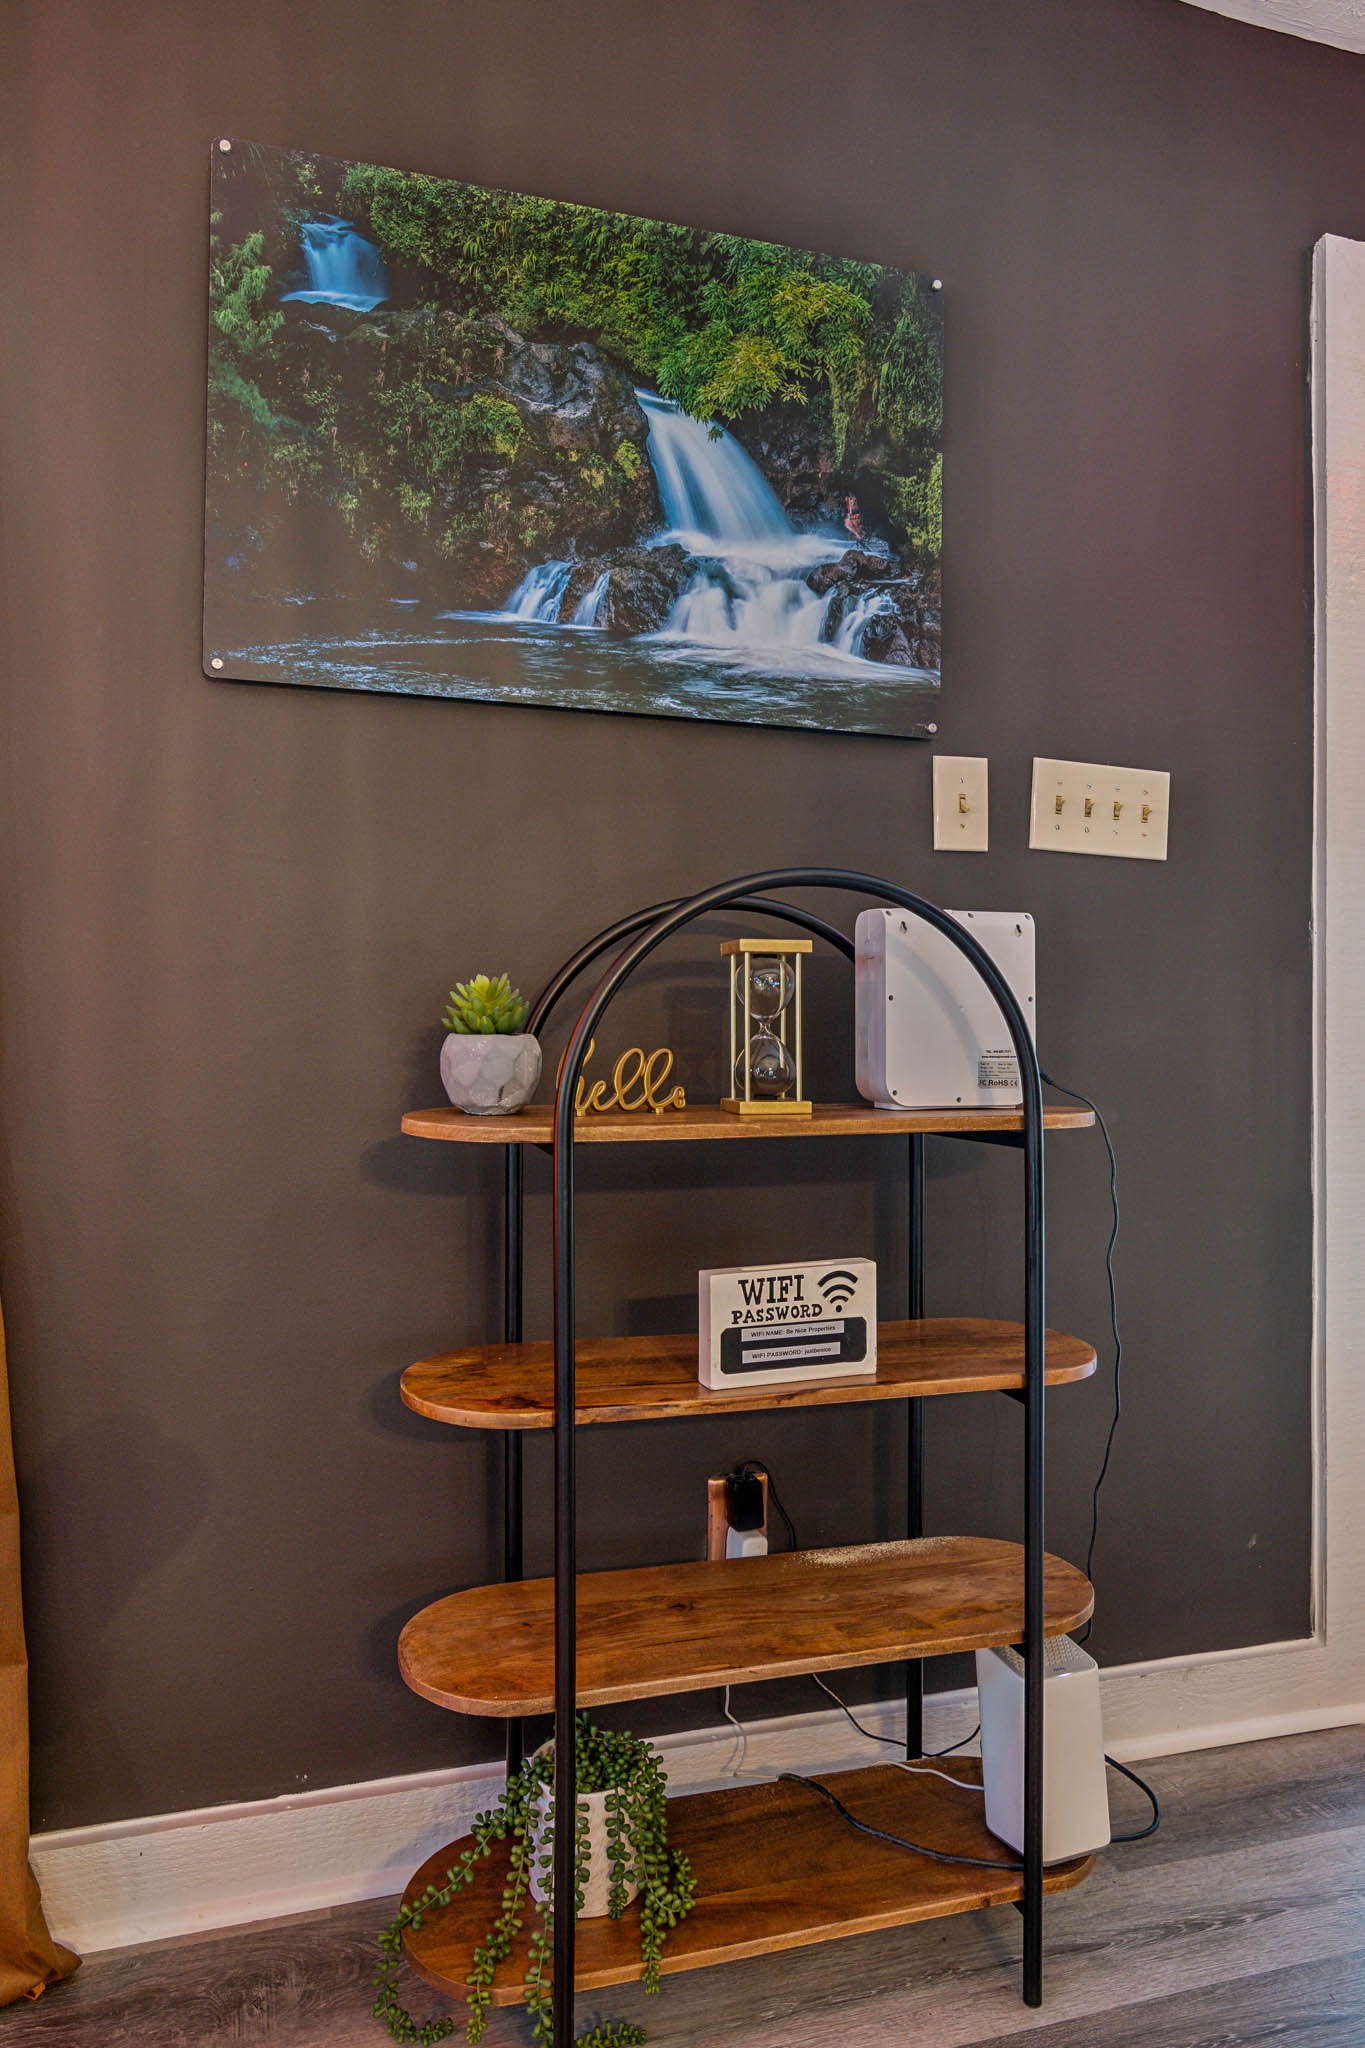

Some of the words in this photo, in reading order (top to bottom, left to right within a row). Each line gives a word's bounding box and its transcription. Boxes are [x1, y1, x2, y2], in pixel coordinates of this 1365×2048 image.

[988, 1079, 1009, 1087] RoHS
[738, 1274, 805, 1306] WIFI
[731, 1303, 823, 1325] PASSWORD
[766, 1329, 785, 1337] NAME:
[808, 1325, 836, 1334] Properties
